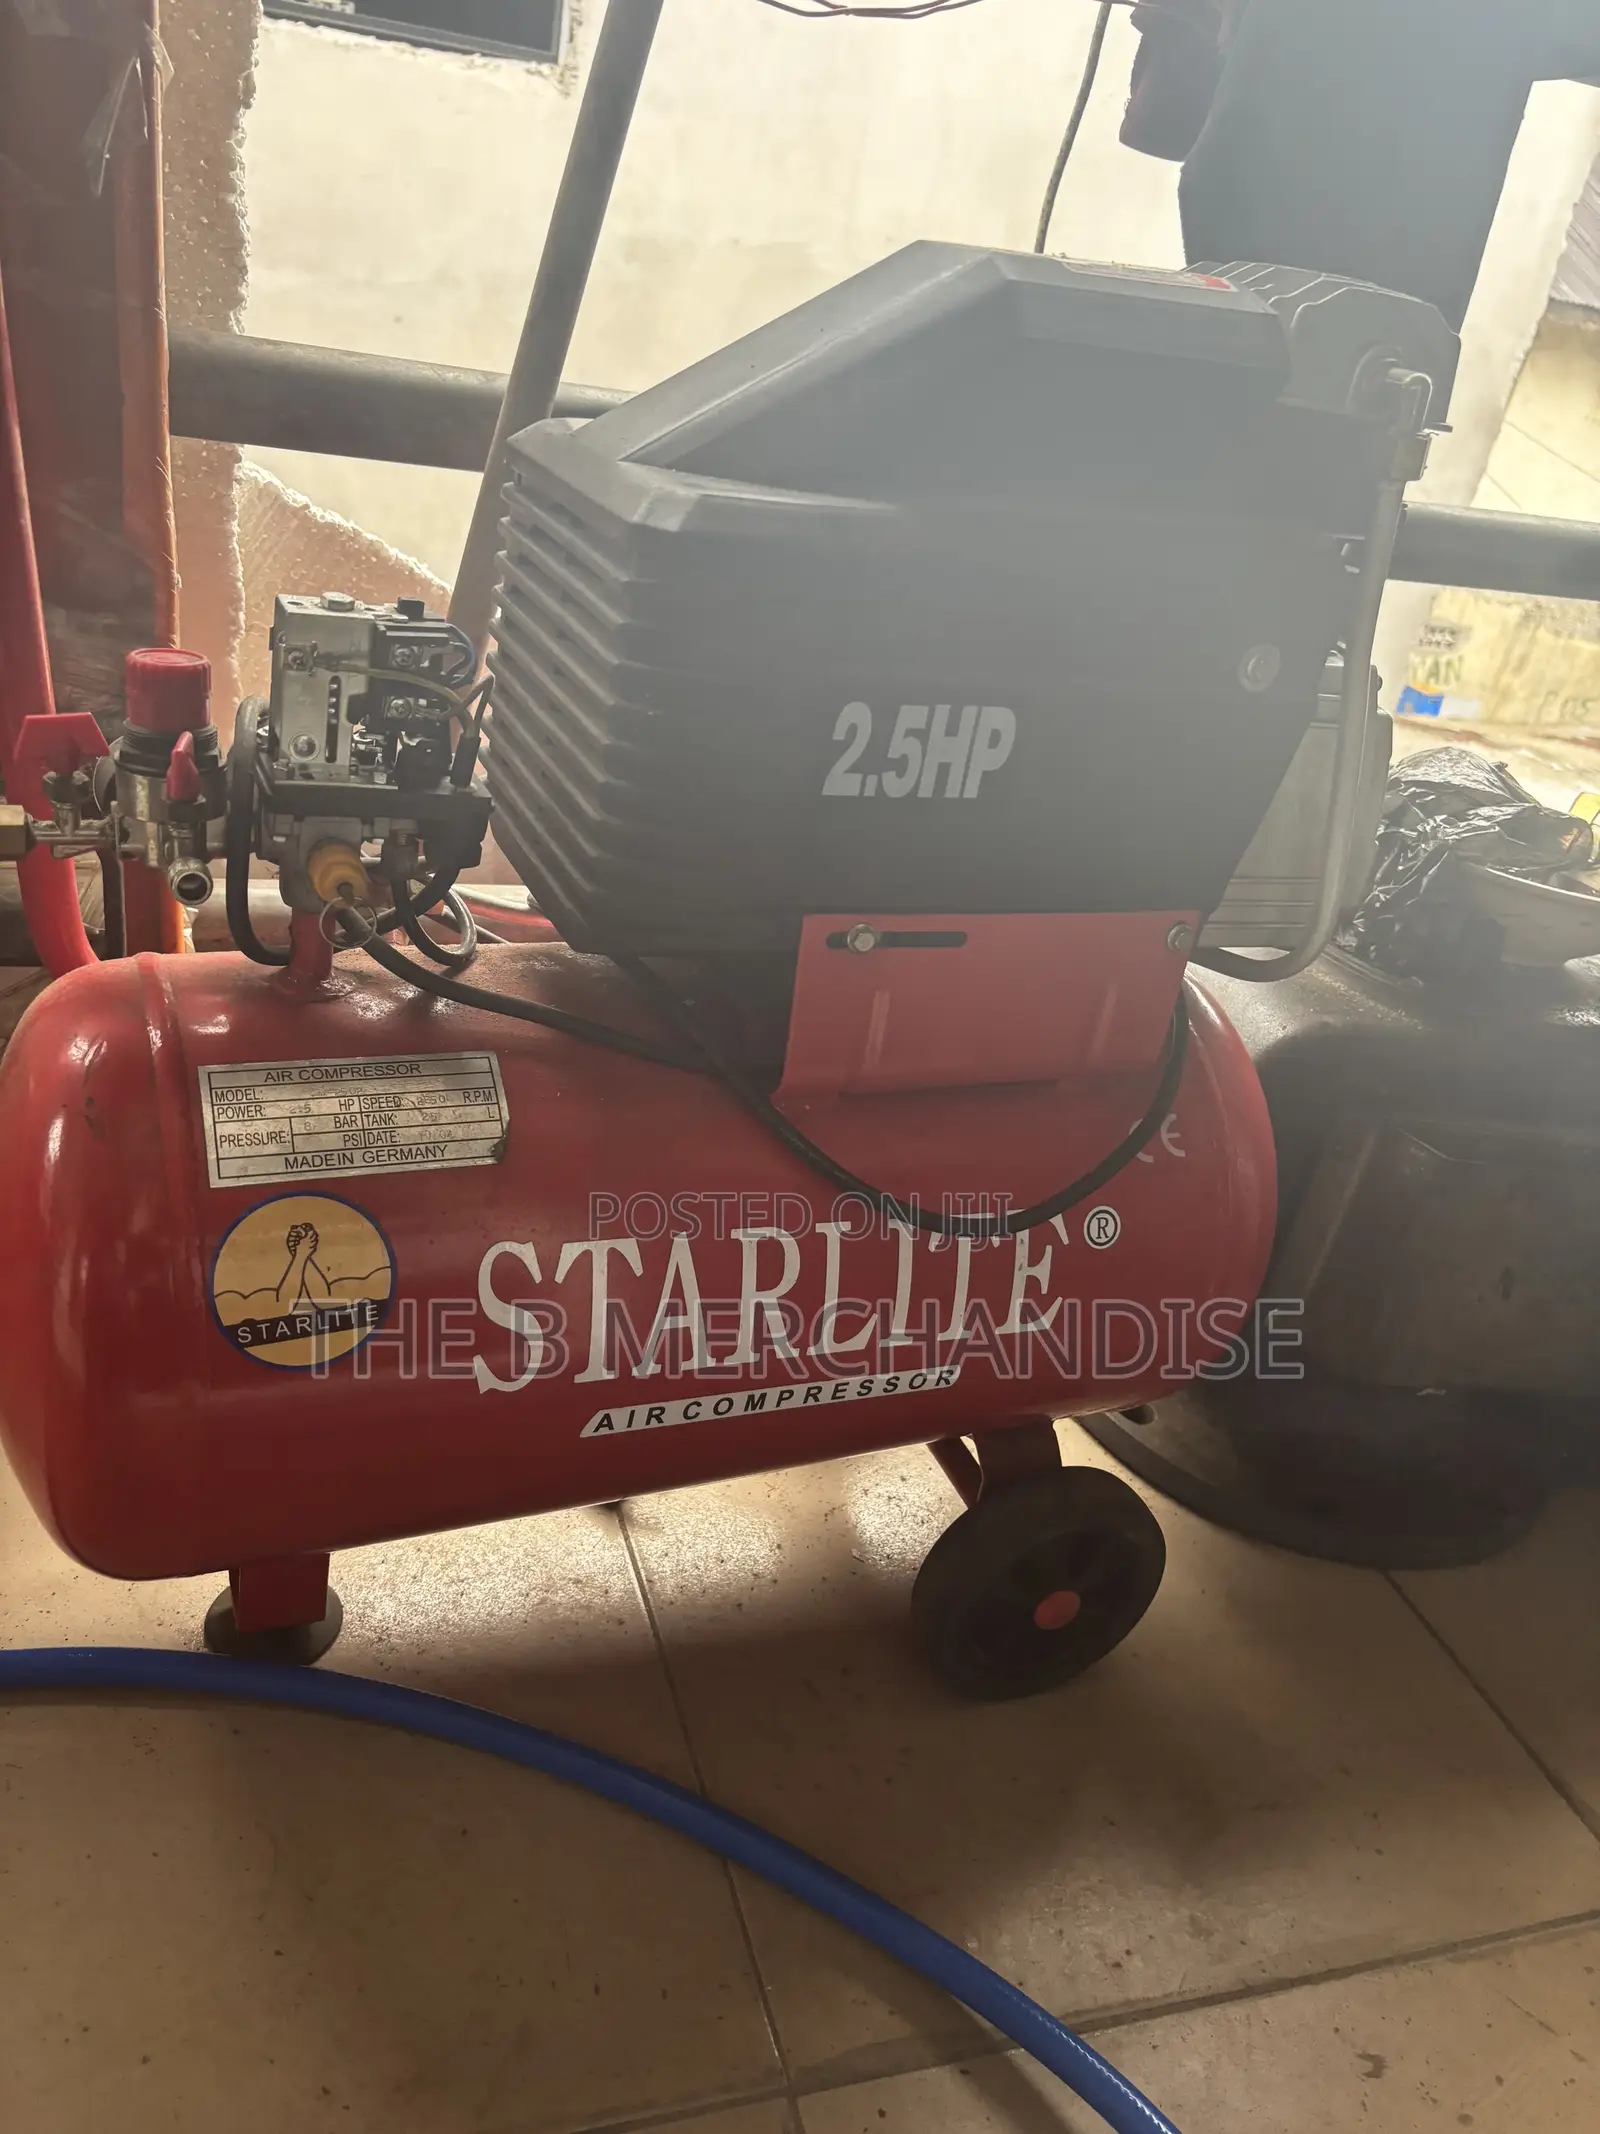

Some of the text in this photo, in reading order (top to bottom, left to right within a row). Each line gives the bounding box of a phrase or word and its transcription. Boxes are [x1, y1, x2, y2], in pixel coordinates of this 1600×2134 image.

[822, 701, 1017, 799] 2.5HP
[264, 1064, 422, 1083] AIR COMPRESSOR
[215, 1088, 264, 1103] MODEL:
[362, 1095, 405, 1110] SPEED:
[462, 1090, 493, 1104] R.P.M
[217, 1105, 266, 1119] POWER:
[339, 1099, 355, 1111] HP
[364, 1112, 399, 1127] TANK:
[487, 1106, 495, 1119] L
[334, 1115, 359, 1129] BAR
[219, 1130, 291, 1148] PRESSURE:
[343, 1132, 363, 1148] PSI
[367, 1130, 401, 1145] DATE:
[362, 1144, 448, 1164] GERMANY
[473, 1208, 1069, 1394] STARLITE
[237, 1304, 379, 1344] STARLITE
[682, 1369, 954, 1420] COMPRESSOR
